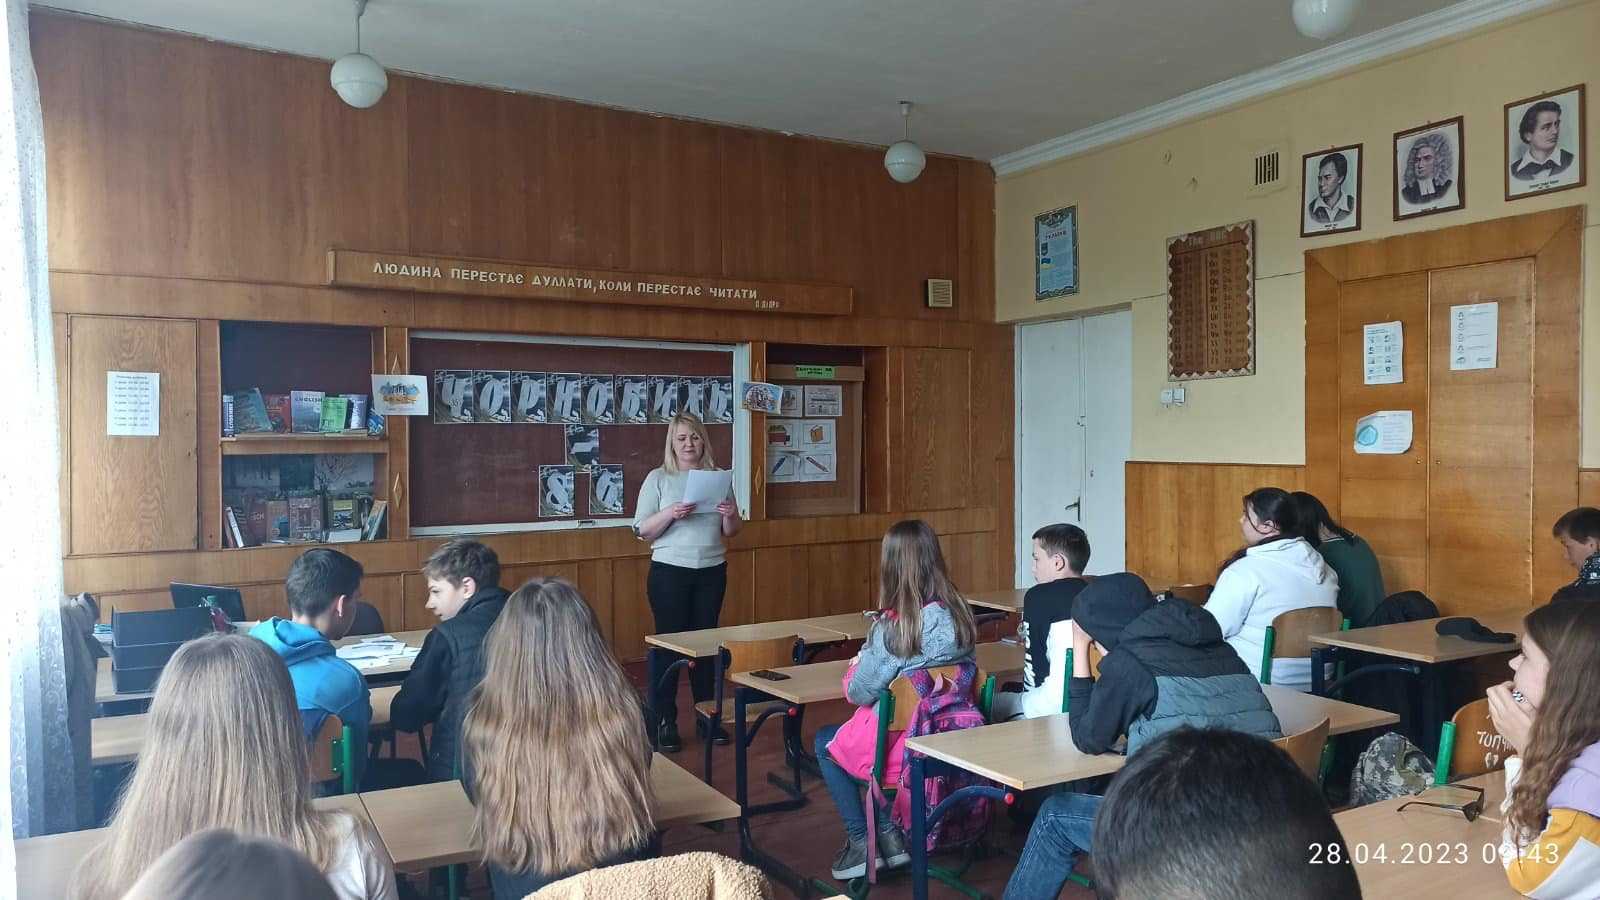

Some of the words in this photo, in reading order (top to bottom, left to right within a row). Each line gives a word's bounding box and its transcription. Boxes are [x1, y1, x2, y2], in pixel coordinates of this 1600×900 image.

[373, 261, 442, 278] ЛЮДИНА
[450, 267, 524, 285] ПЕРЕСТАЄ
[599, 279, 632, 293] КОЛИ
[637, 281, 702, 296] ПЕРЕСТАЄ
[709, 287, 757, 300] ЧИТАТИ
[441, 375, 728, 418] ЧОРНОБИЛЬ
